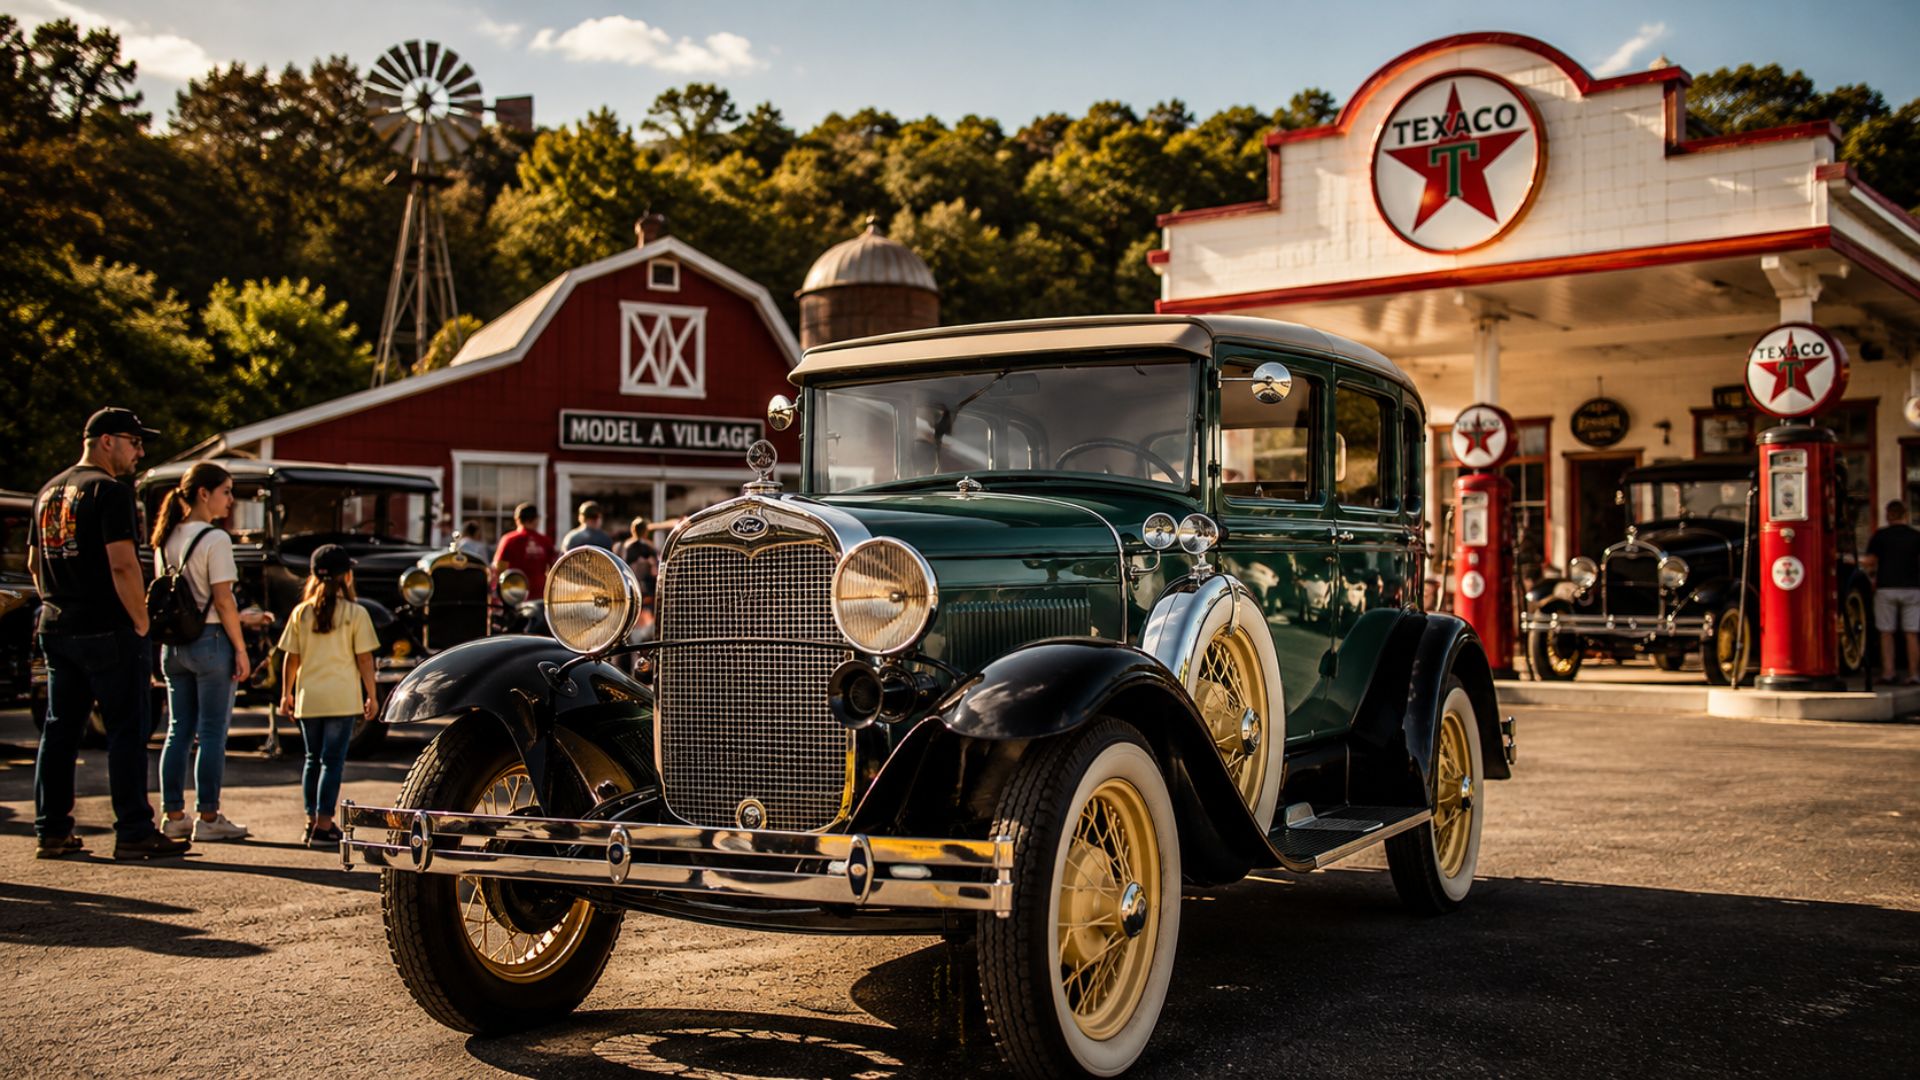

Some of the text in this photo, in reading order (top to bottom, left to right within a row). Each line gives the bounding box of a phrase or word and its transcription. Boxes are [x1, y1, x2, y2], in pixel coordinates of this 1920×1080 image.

[1392, 103, 1517, 145] TEXACO
[1428, 140, 1479, 198] T
[1757, 342, 1825, 359] TEXACO
[1777, 360, 1804, 388] T
[571, 418, 755, 448] MODEL A VILLAGE
